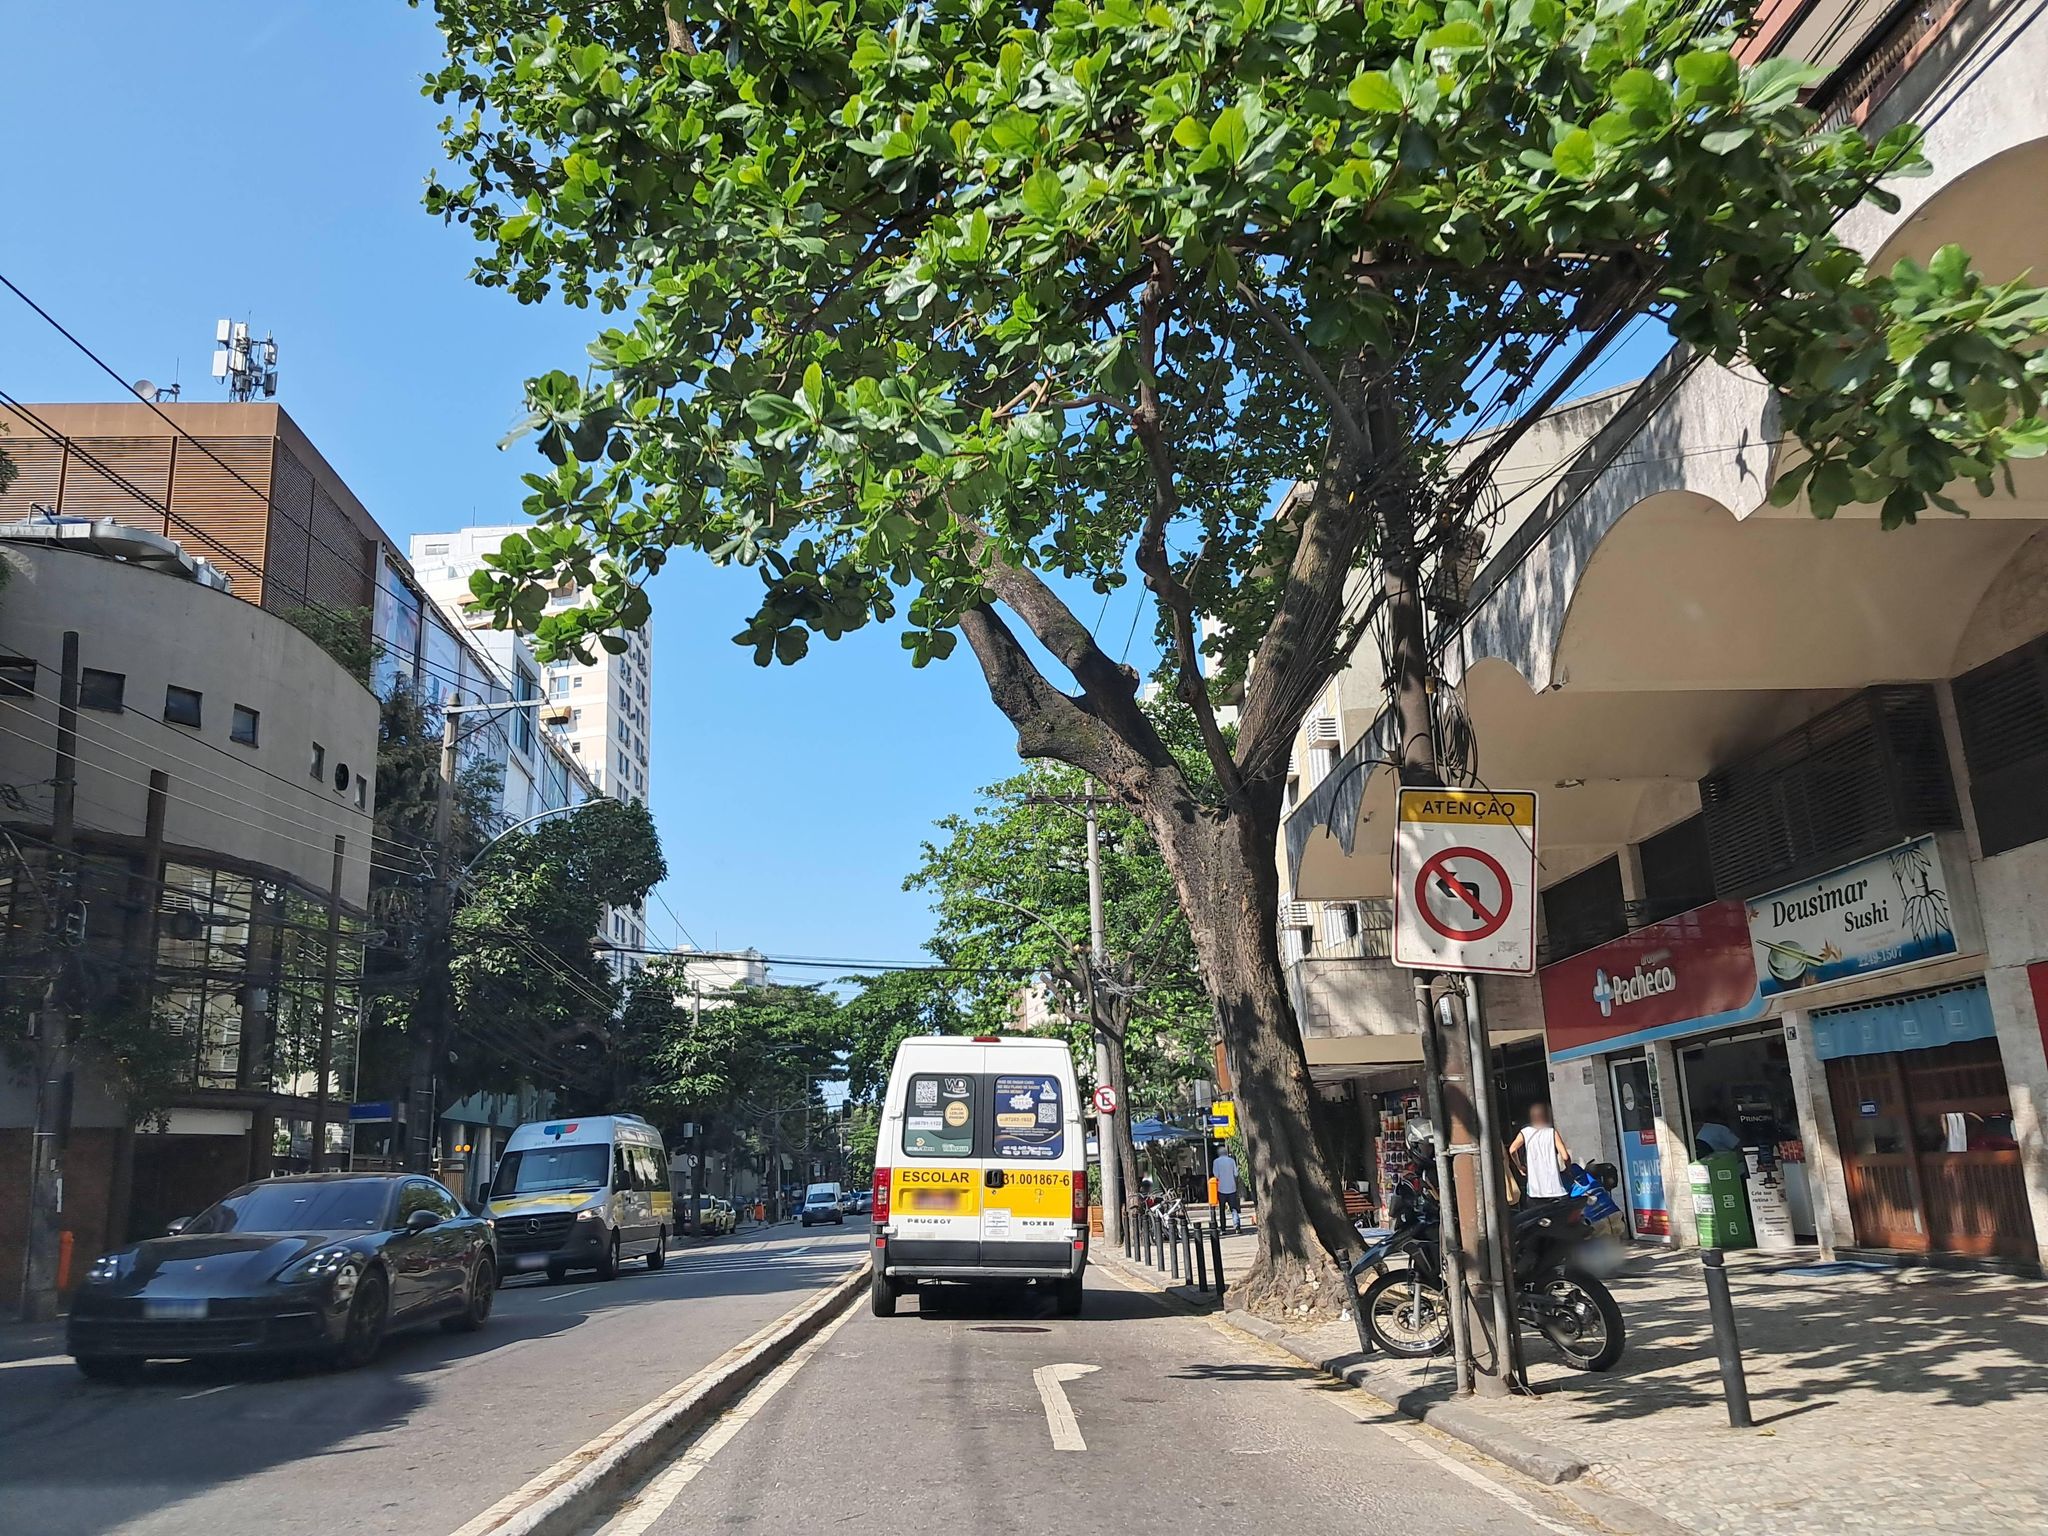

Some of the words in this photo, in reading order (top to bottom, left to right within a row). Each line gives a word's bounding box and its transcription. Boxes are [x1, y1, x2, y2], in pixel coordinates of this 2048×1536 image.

[1422, 798, 1515, 820] ATENÇÃO
[1771, 878, 1868, 928] Deusimar
[1844, 899, 1889, 932] Sushi
[1612, 966, 1676, 1006] Pacheco
[902, 1171, 970, 1183] ESCOLAR
